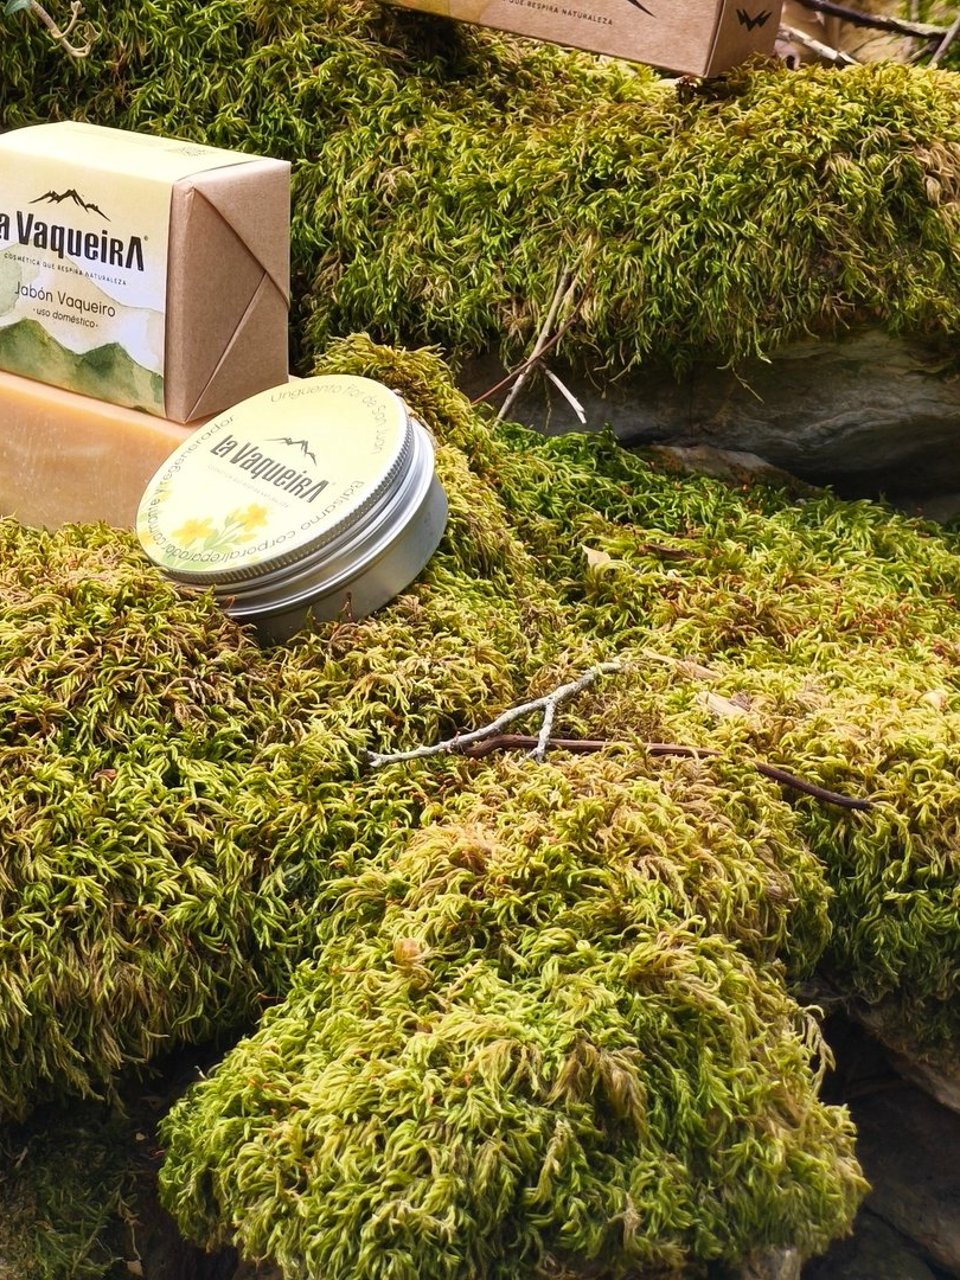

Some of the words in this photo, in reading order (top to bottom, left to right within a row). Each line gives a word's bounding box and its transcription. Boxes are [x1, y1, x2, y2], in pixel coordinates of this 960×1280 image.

[527, 0, 559, 14] RESPIRA
[562, 8, 613, 26] NATURALEZA
[43, 261, 55, 270] QUE
[57, 264, 83, 276] RESPIRA
[84, 272, 127, 286] NATURALEZA
[14, 281, 54, 303] Jabón
[57, 291, 116, 318] Vaqueiro
[209, 434, 237, 458] La
